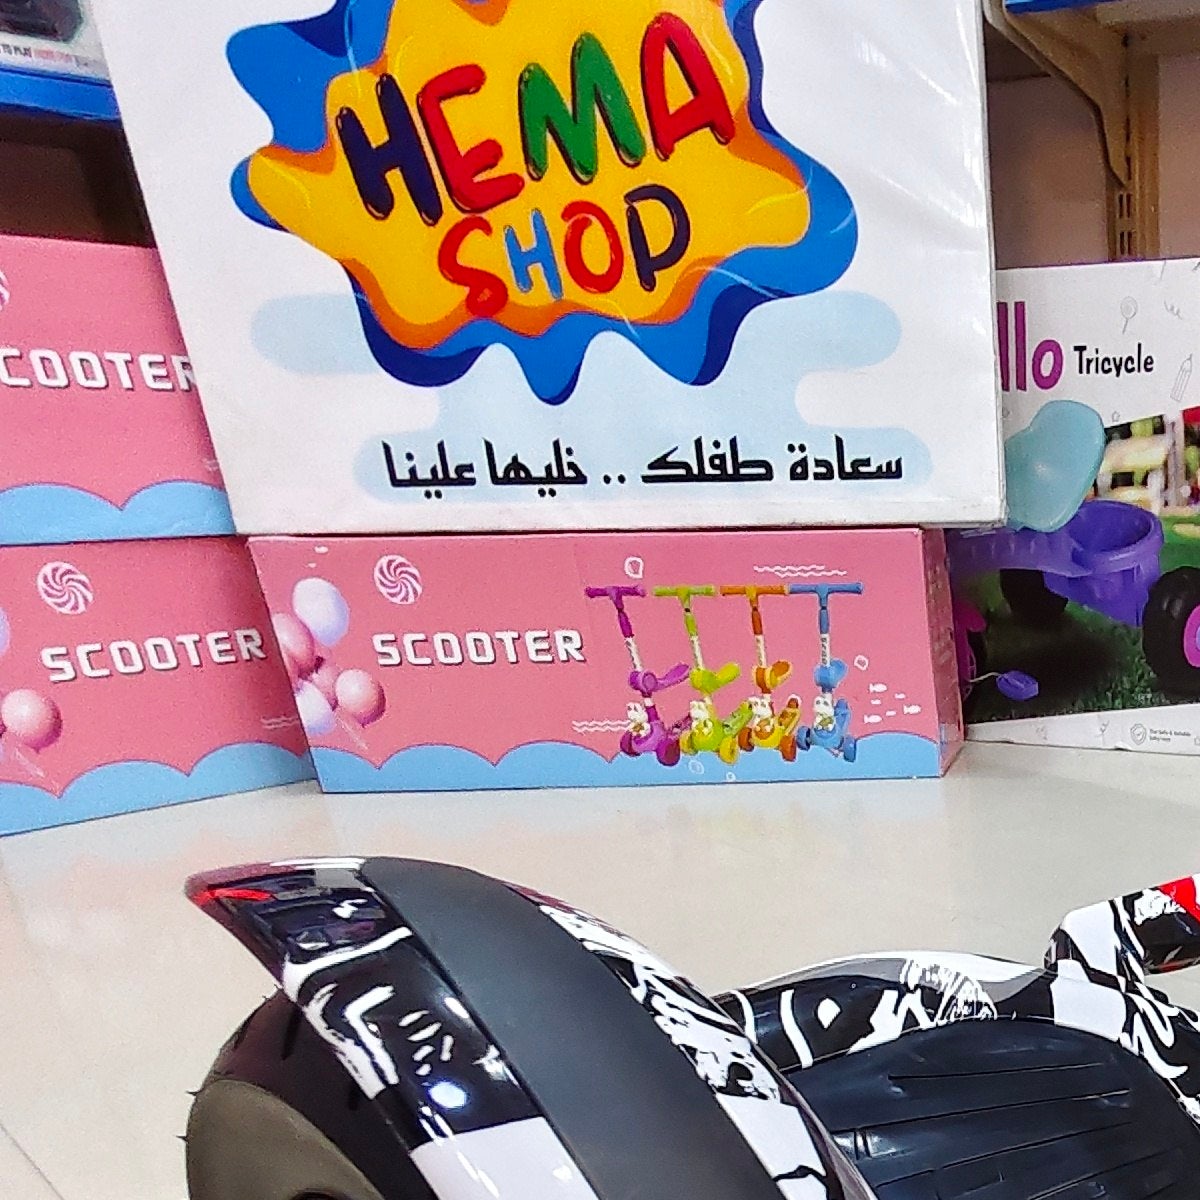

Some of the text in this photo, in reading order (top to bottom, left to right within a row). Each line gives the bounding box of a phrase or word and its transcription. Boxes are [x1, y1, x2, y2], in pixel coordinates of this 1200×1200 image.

[335, 12, 736, 227] HEMA
[437, 183, 692, 318] SHOP
[1073, 342, 1154, 378] Tricycle
[382, 439, 477, 500] علينا
[483, 436, 588, 498] خليها
[641, 435, 774, 483] طفلك
[787, 434, 903, 481] سعادة
[40, 628, 267, 682] SCOOTER
[372, 629, 586, 666] SCOOTER
